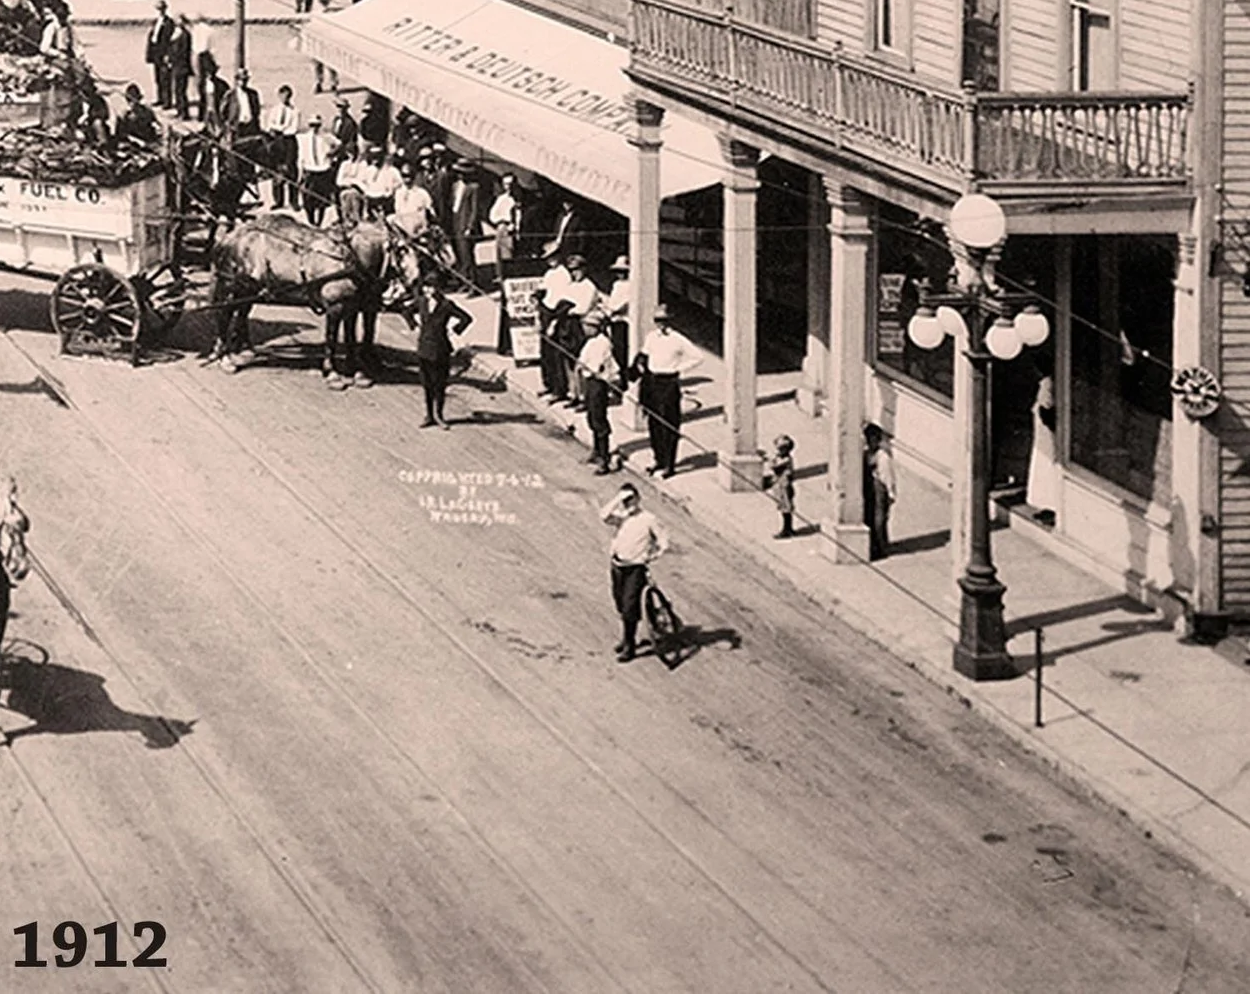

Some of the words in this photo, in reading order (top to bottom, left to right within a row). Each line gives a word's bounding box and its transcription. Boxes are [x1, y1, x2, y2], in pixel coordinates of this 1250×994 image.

[382, 17, 463, 56] RITTER
[449, 46, 479, 62] &
[465, 52, 572, 100] DEUTSCH
[20, 182, 68, 201] FUEL
